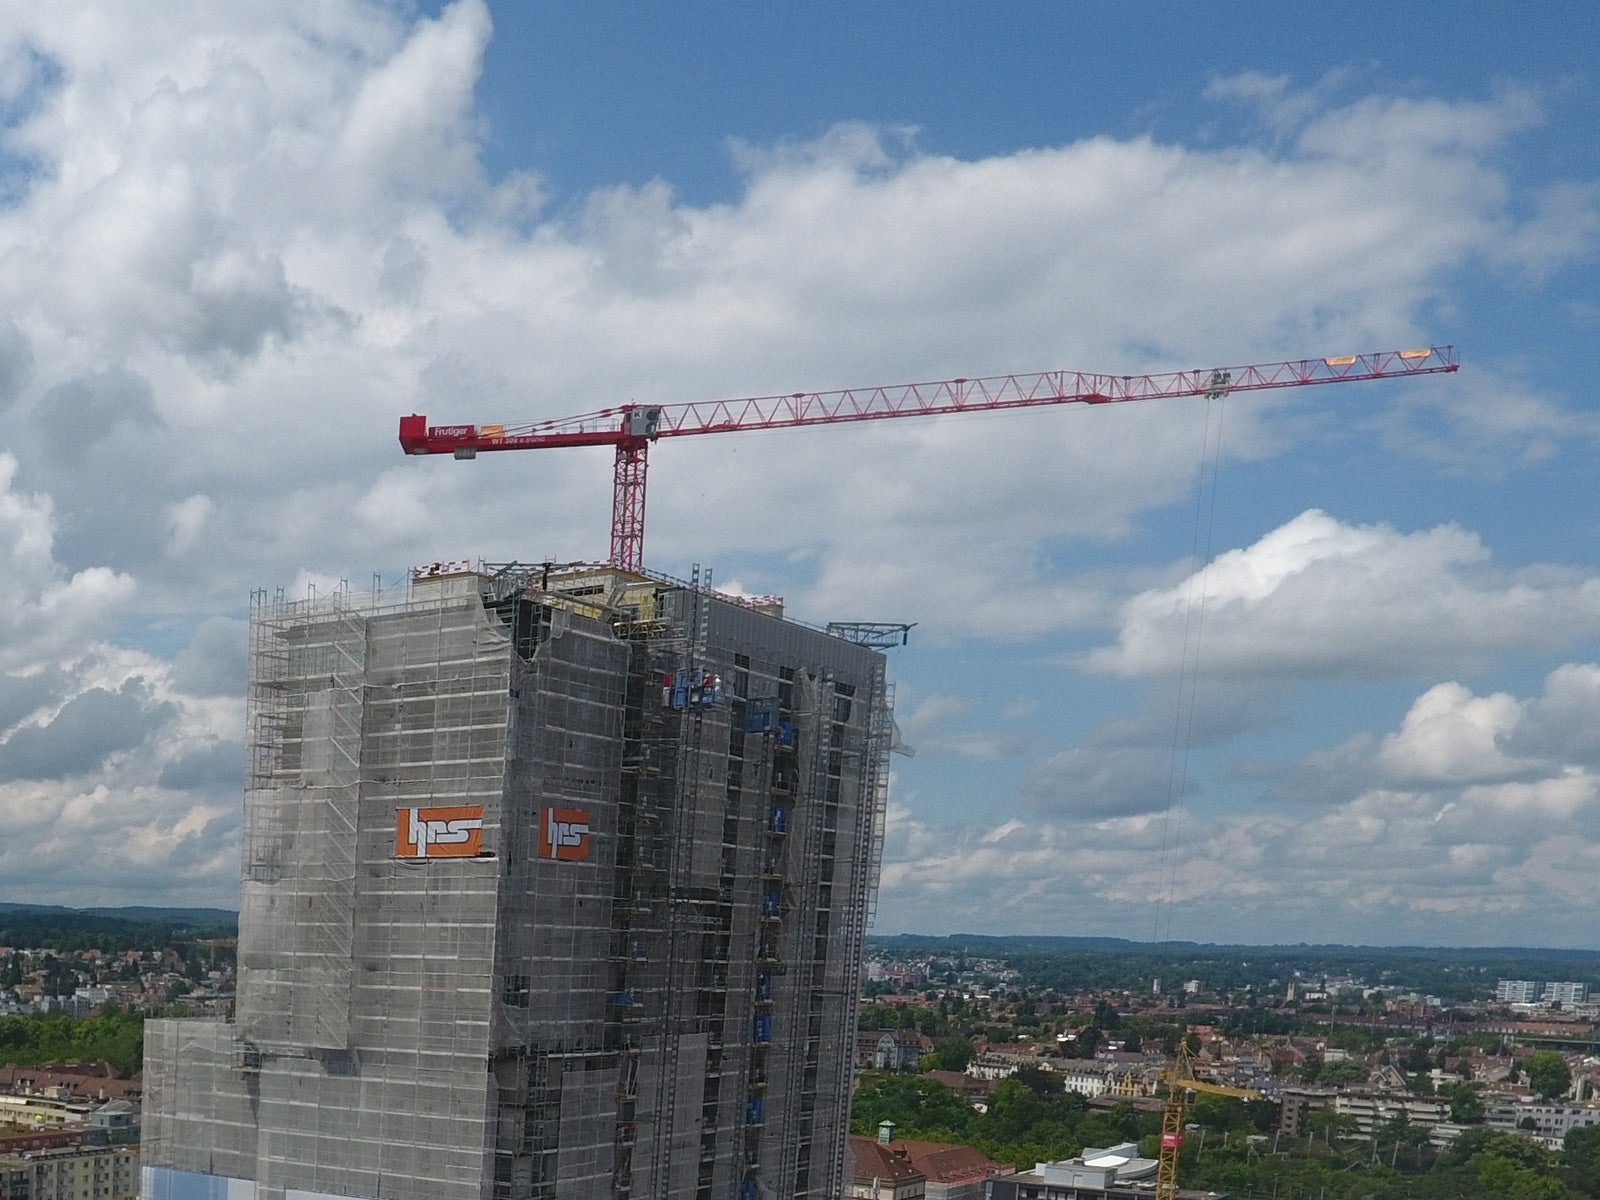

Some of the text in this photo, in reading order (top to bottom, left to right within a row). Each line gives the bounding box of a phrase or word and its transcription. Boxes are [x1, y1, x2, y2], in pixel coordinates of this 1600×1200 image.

[434, 426, 469, 437] Frutiger
[408, 808, 482, 857] hrs
[547, 807, 589, 859] hrs
